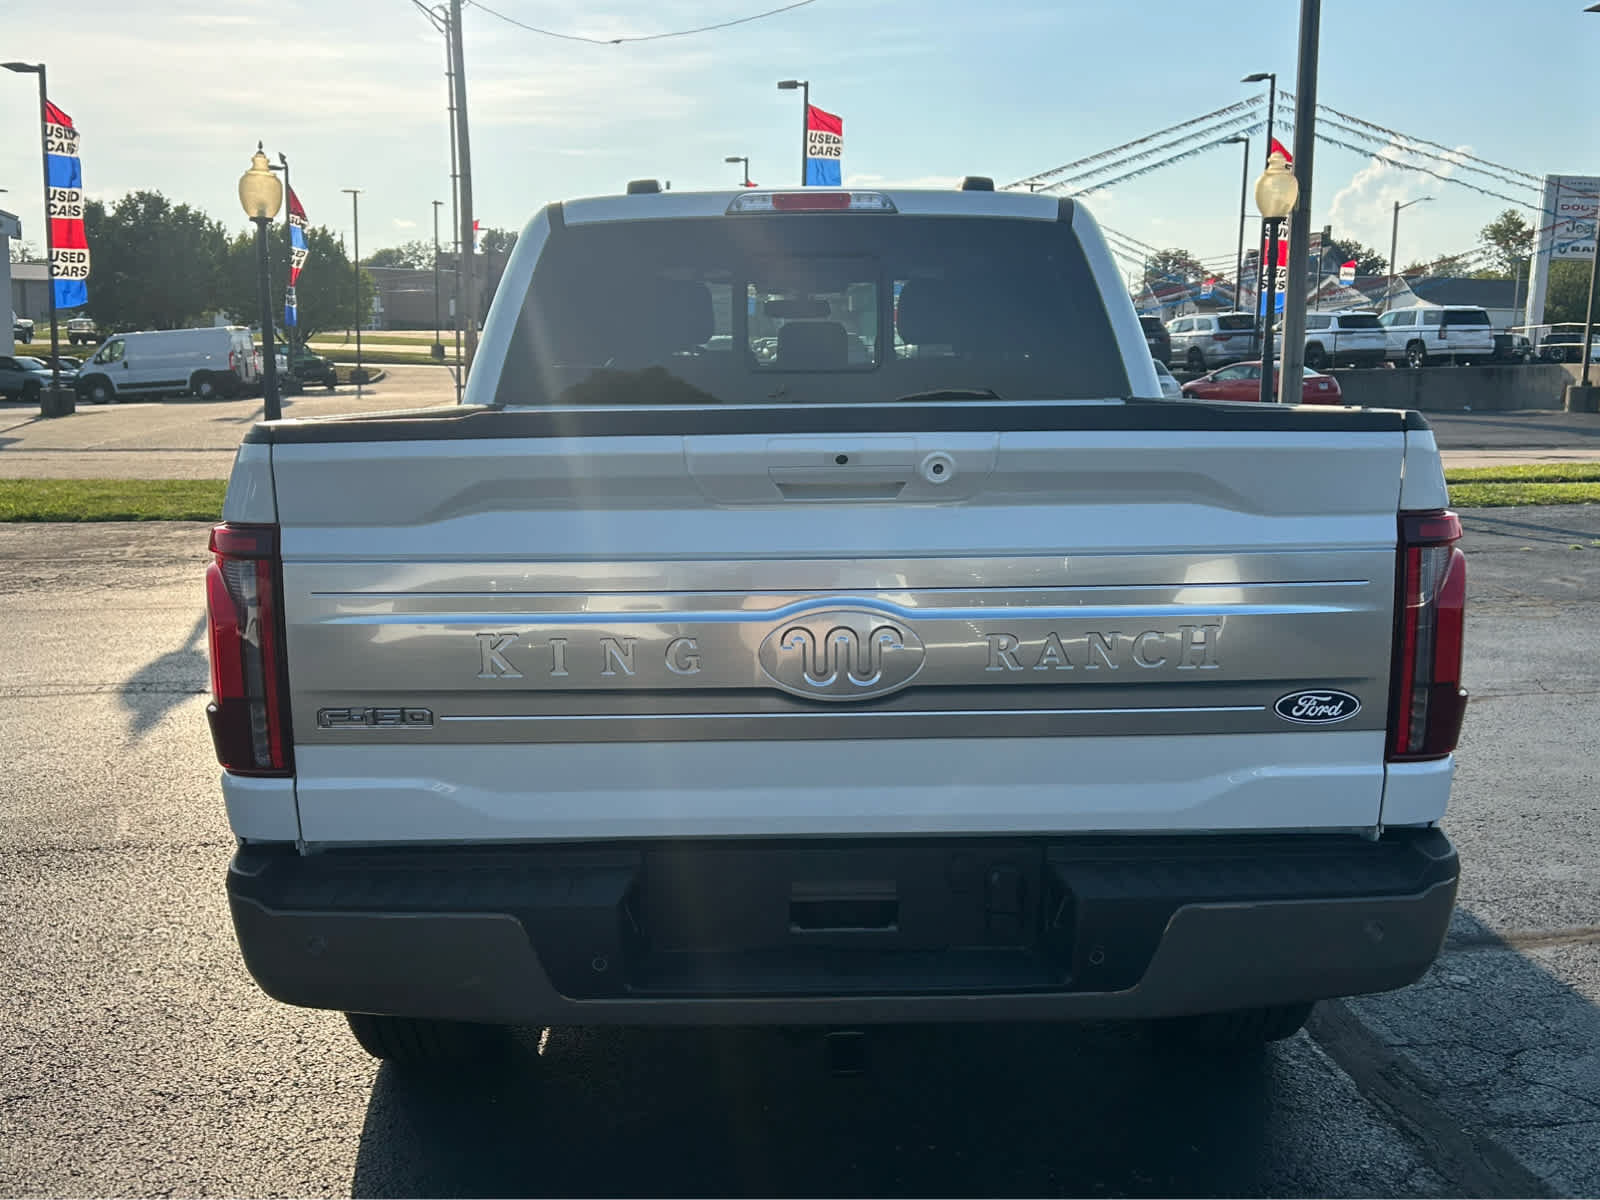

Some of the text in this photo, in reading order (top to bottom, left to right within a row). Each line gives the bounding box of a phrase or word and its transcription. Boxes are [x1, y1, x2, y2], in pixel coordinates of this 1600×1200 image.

[809, 145, 841, 157] CARS
[49, 250, 86, 263] USED
[51, 265, 88, 277] CARS
[474, 623, 1222, 680] KING RANCH
[1291, 695, 1344, 716] Ford
[317, 707, 433, 729] F-150
